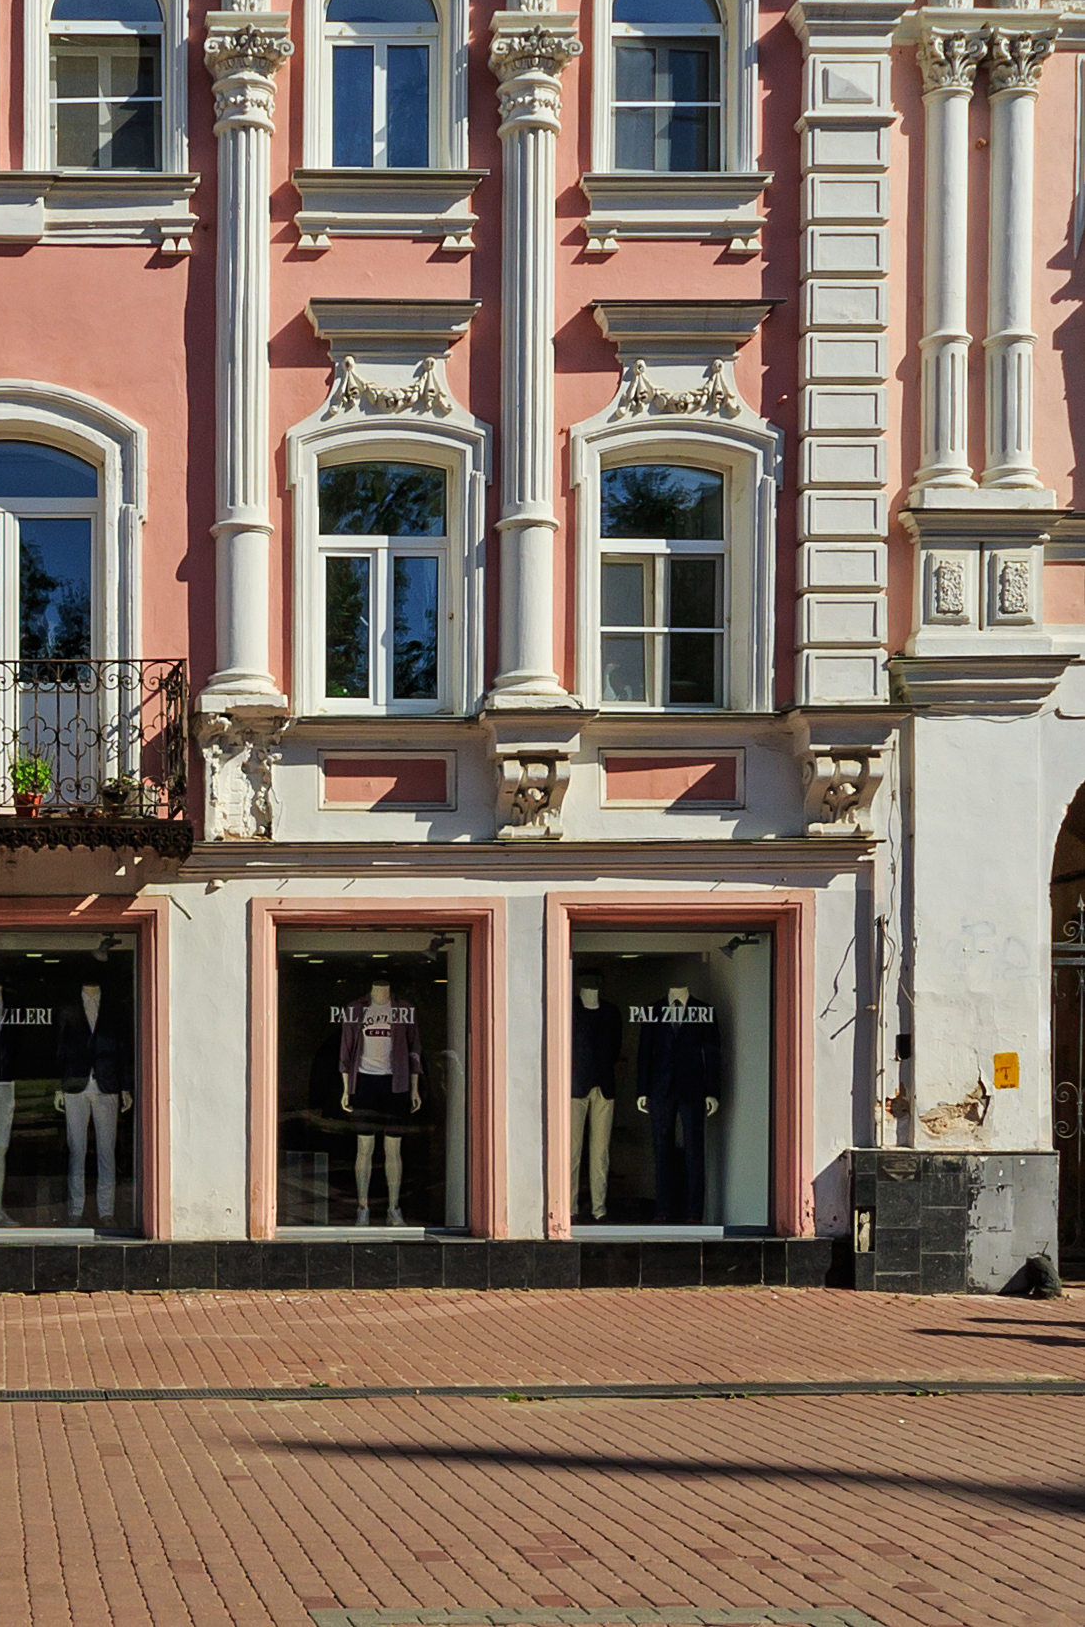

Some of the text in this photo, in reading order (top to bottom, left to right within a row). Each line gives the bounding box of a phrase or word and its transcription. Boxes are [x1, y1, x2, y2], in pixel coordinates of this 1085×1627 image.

[0, 1008, 53, 1025] ZILERI
[329, 1006, 359, 1023] PAL
[629, 1006, 714, 1023] PAL ZILERI
